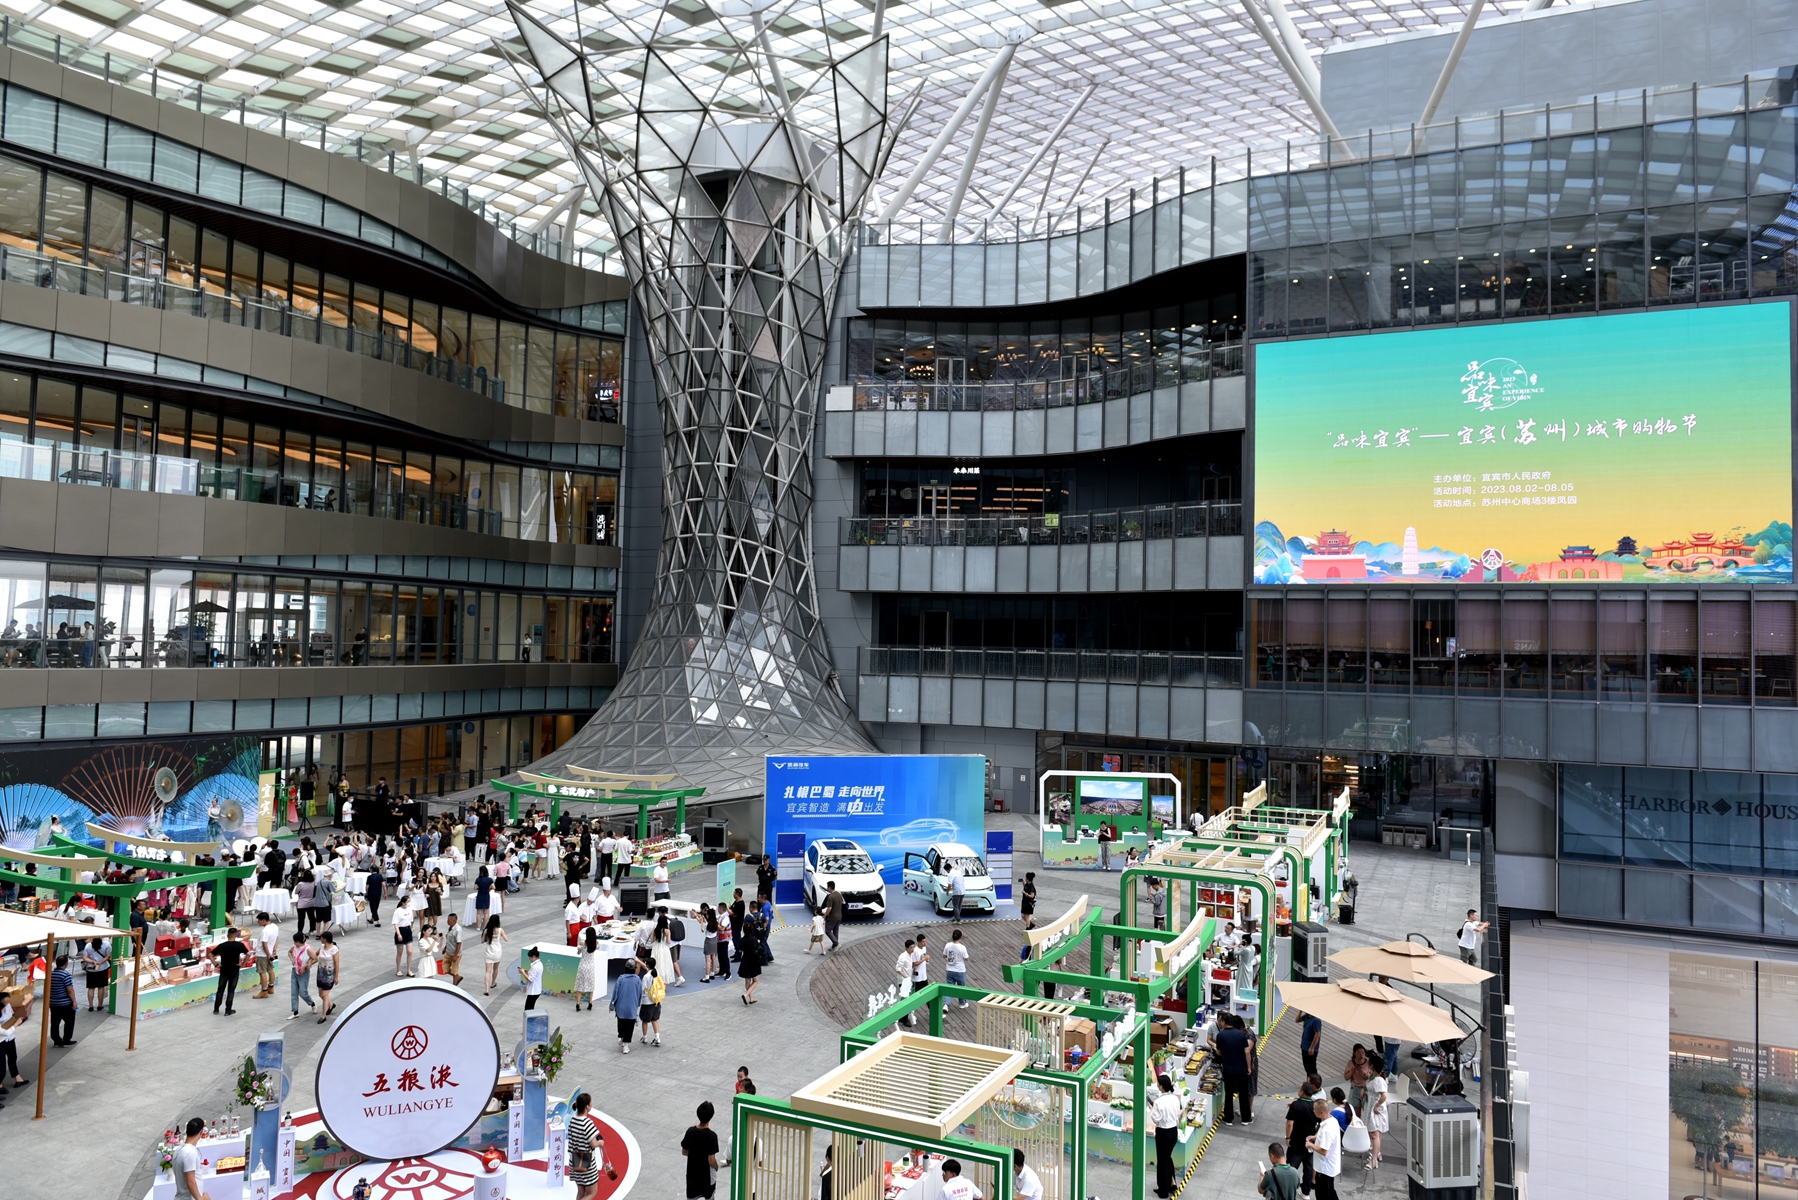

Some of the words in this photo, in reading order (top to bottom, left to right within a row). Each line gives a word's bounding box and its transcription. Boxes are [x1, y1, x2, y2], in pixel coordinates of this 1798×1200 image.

[783, 785, 835, 799] 扎根巴蜀
[838, 785, 885, 801] 走向世界
[785, 802, 830, 813] 宜宾智造
[1620, 794, 1711, 815] HARBOR
[386, 861, 396, 870] 23
[361, 1063, 460, 1098] 五粮液
[363, 1097, 454, 1118] WULIANGYE
